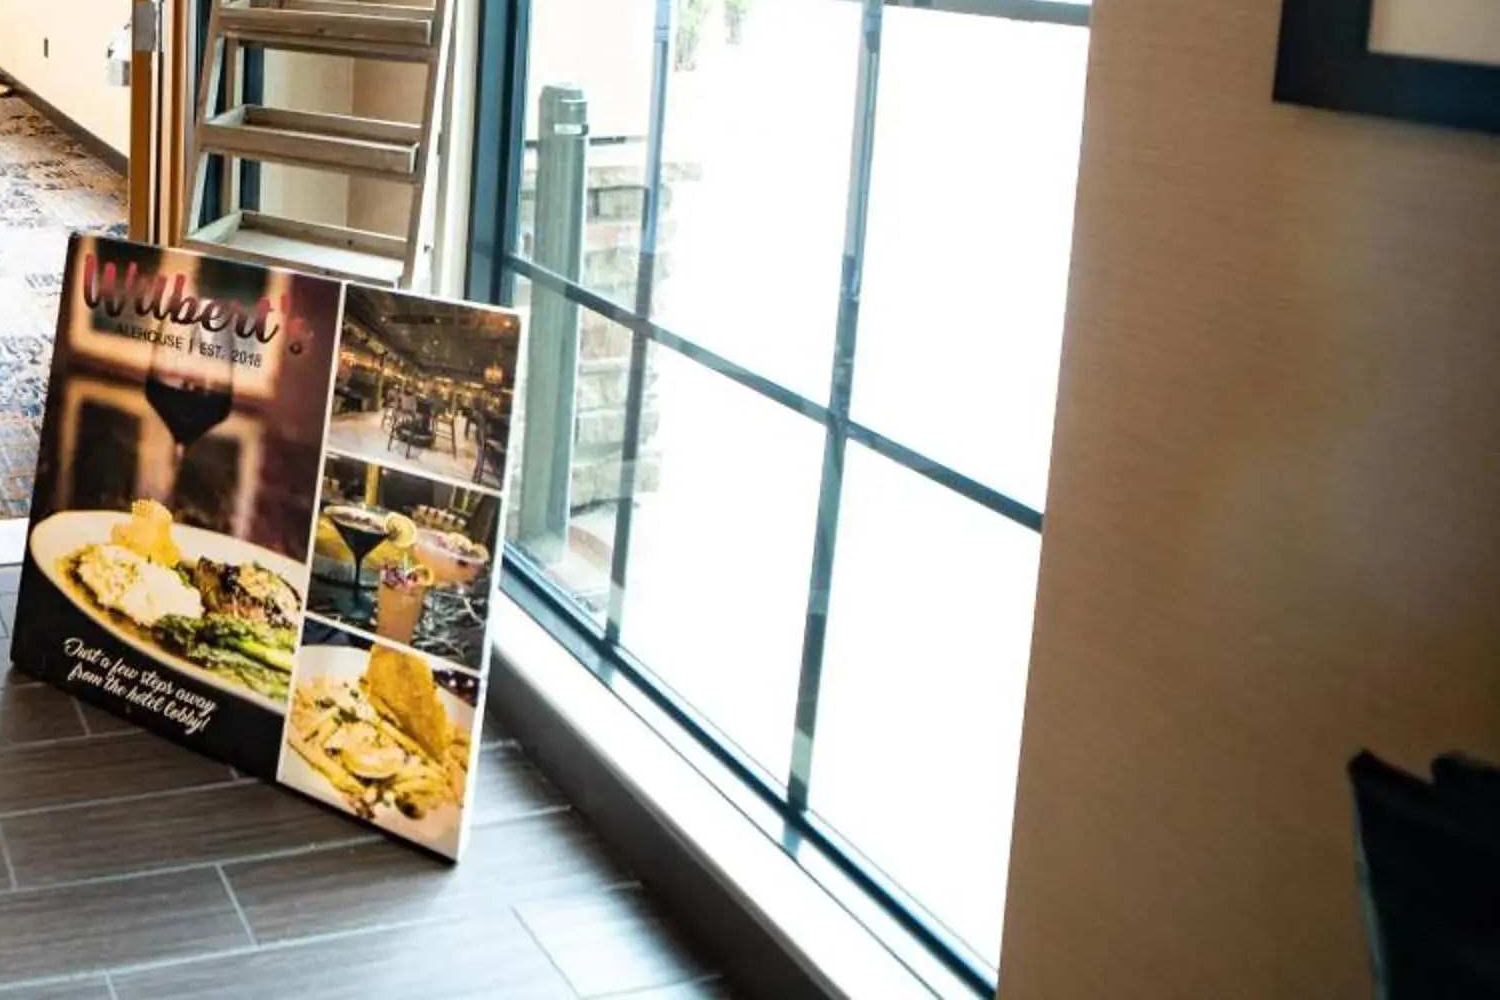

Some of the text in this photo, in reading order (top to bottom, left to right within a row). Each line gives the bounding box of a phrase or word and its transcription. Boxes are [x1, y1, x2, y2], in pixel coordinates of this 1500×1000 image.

[64, 637, 218, 718] Just a few steps away
[67, 662, 211, 735] from the hotel lobby!
